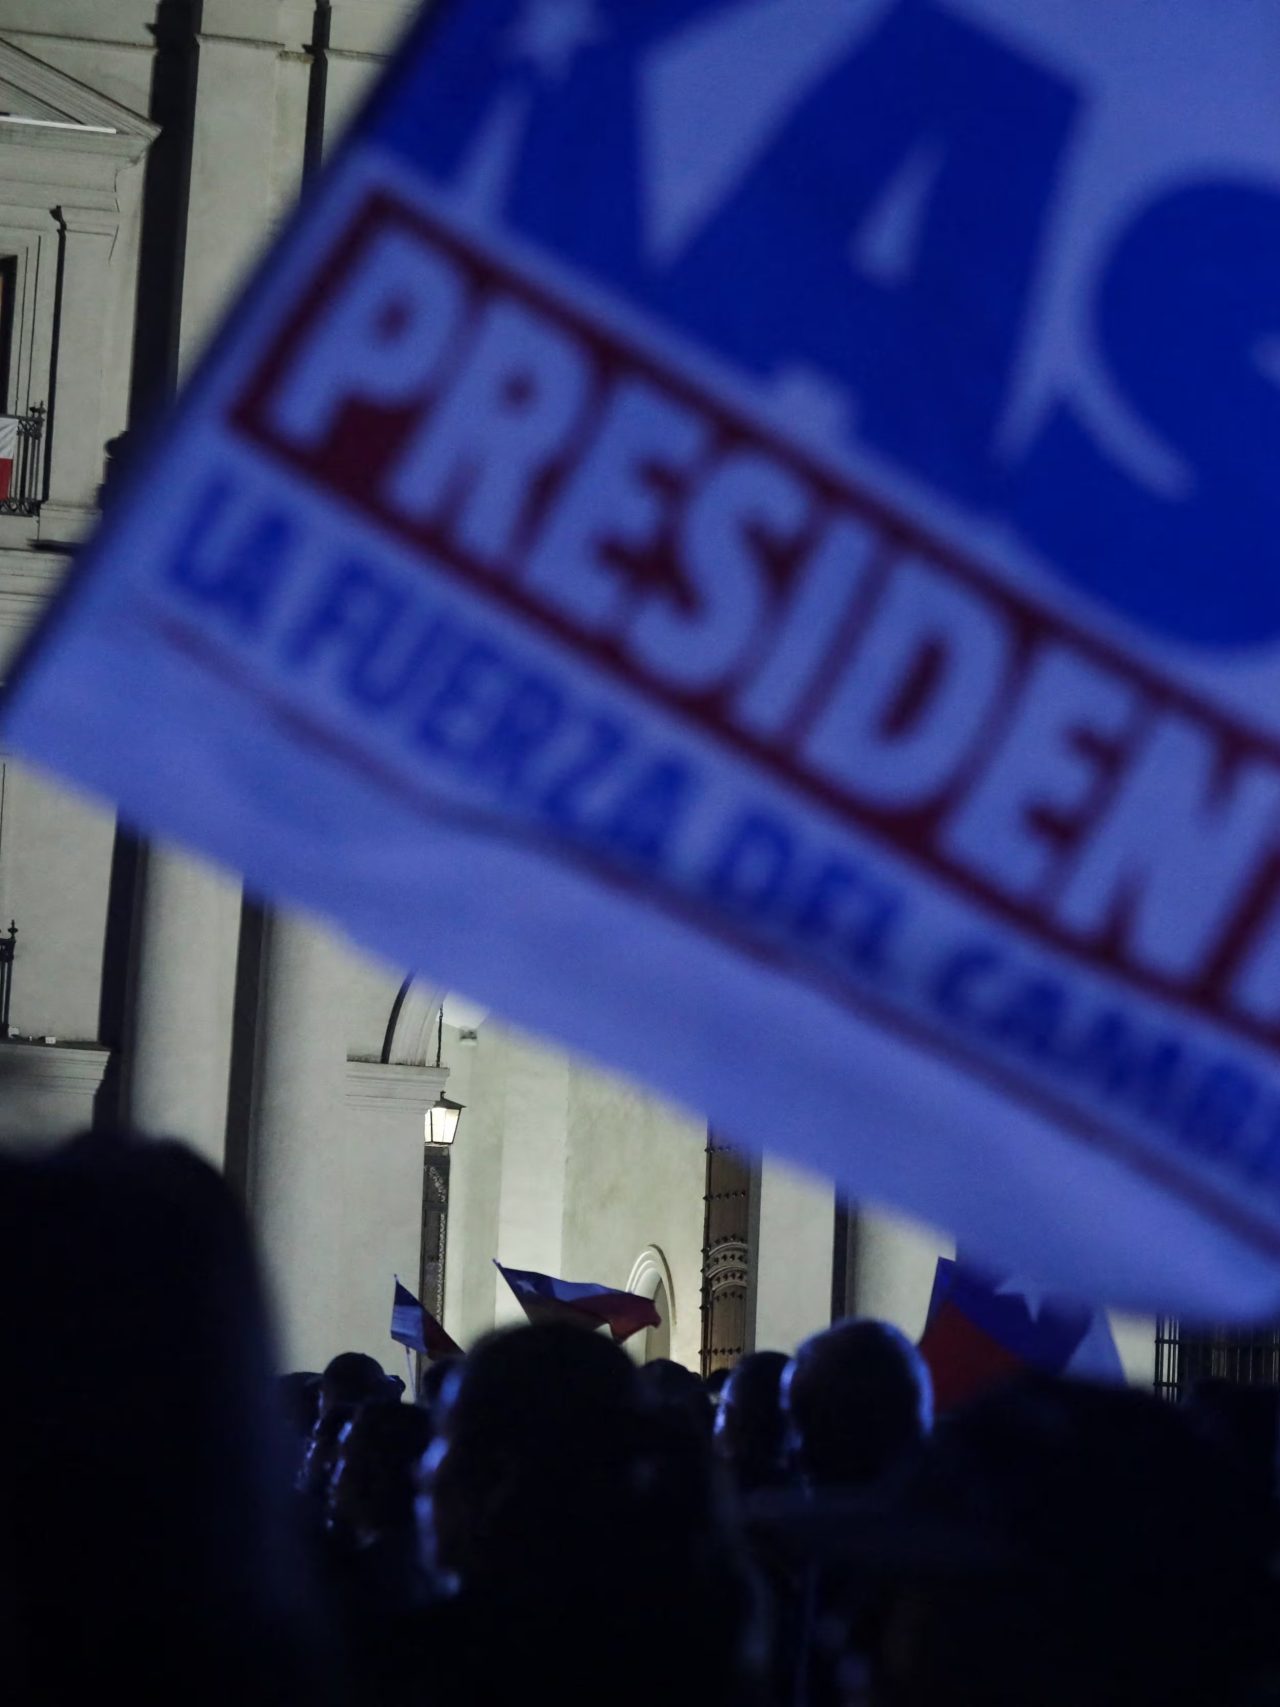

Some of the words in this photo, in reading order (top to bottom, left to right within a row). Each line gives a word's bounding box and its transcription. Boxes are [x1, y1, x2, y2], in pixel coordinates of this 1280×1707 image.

[162, 466, 305, 638] LA
[277, 548, 694, 878] FUERZA
[702, 798, 908, 972] DEL
